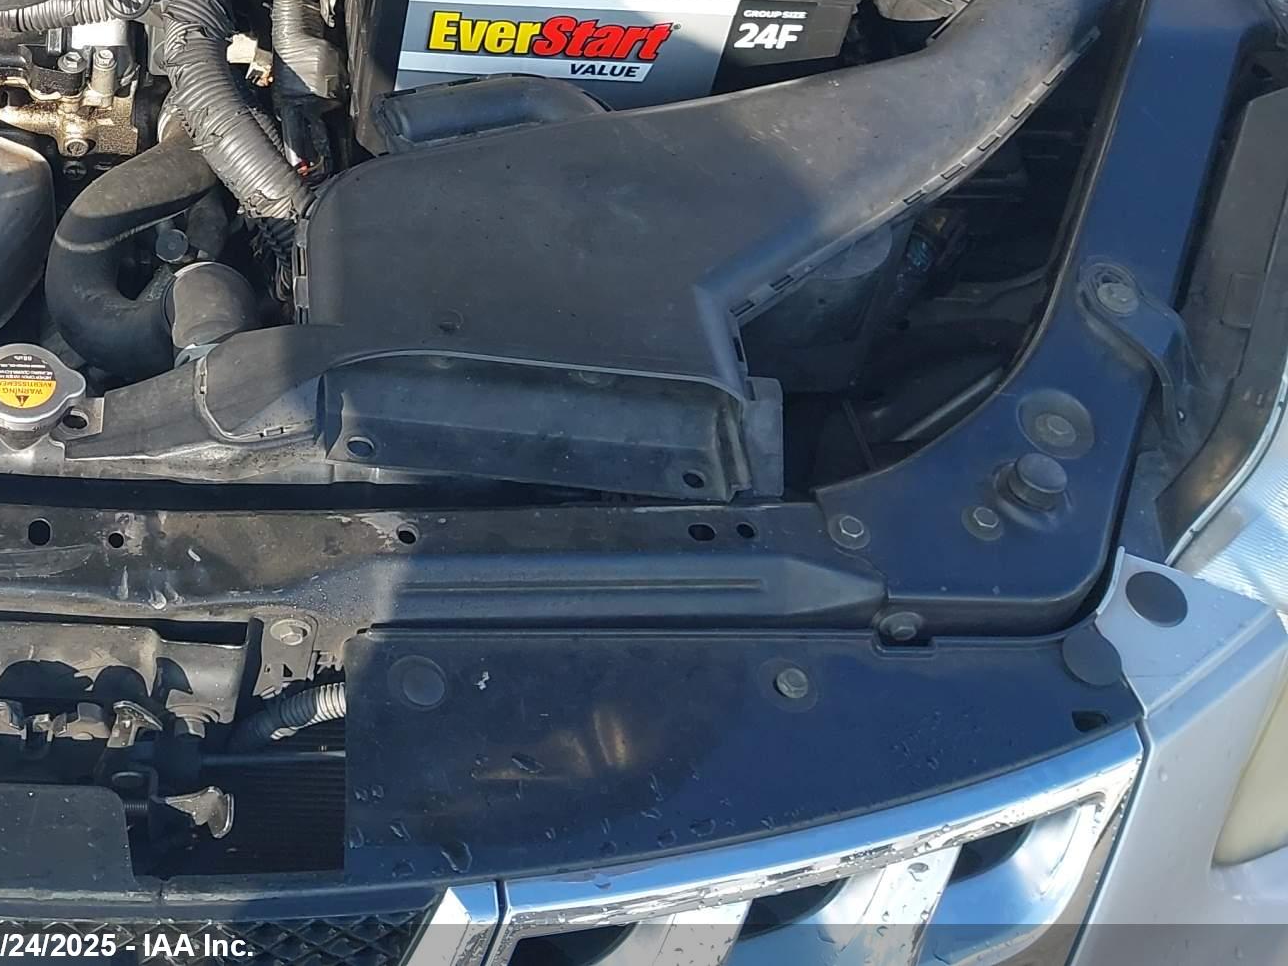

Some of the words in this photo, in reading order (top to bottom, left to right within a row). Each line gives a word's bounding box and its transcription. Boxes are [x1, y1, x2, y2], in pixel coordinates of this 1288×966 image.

[743, 10, 782, 18] GROUP
[781, 11, 808, 19] SIZE
[428, 11, 674, 61] EverStart
[734, 22, 803, 50] 24F
[569, 63, 640, 78] VALUE
[2, 387, 43, 395] WARNING
